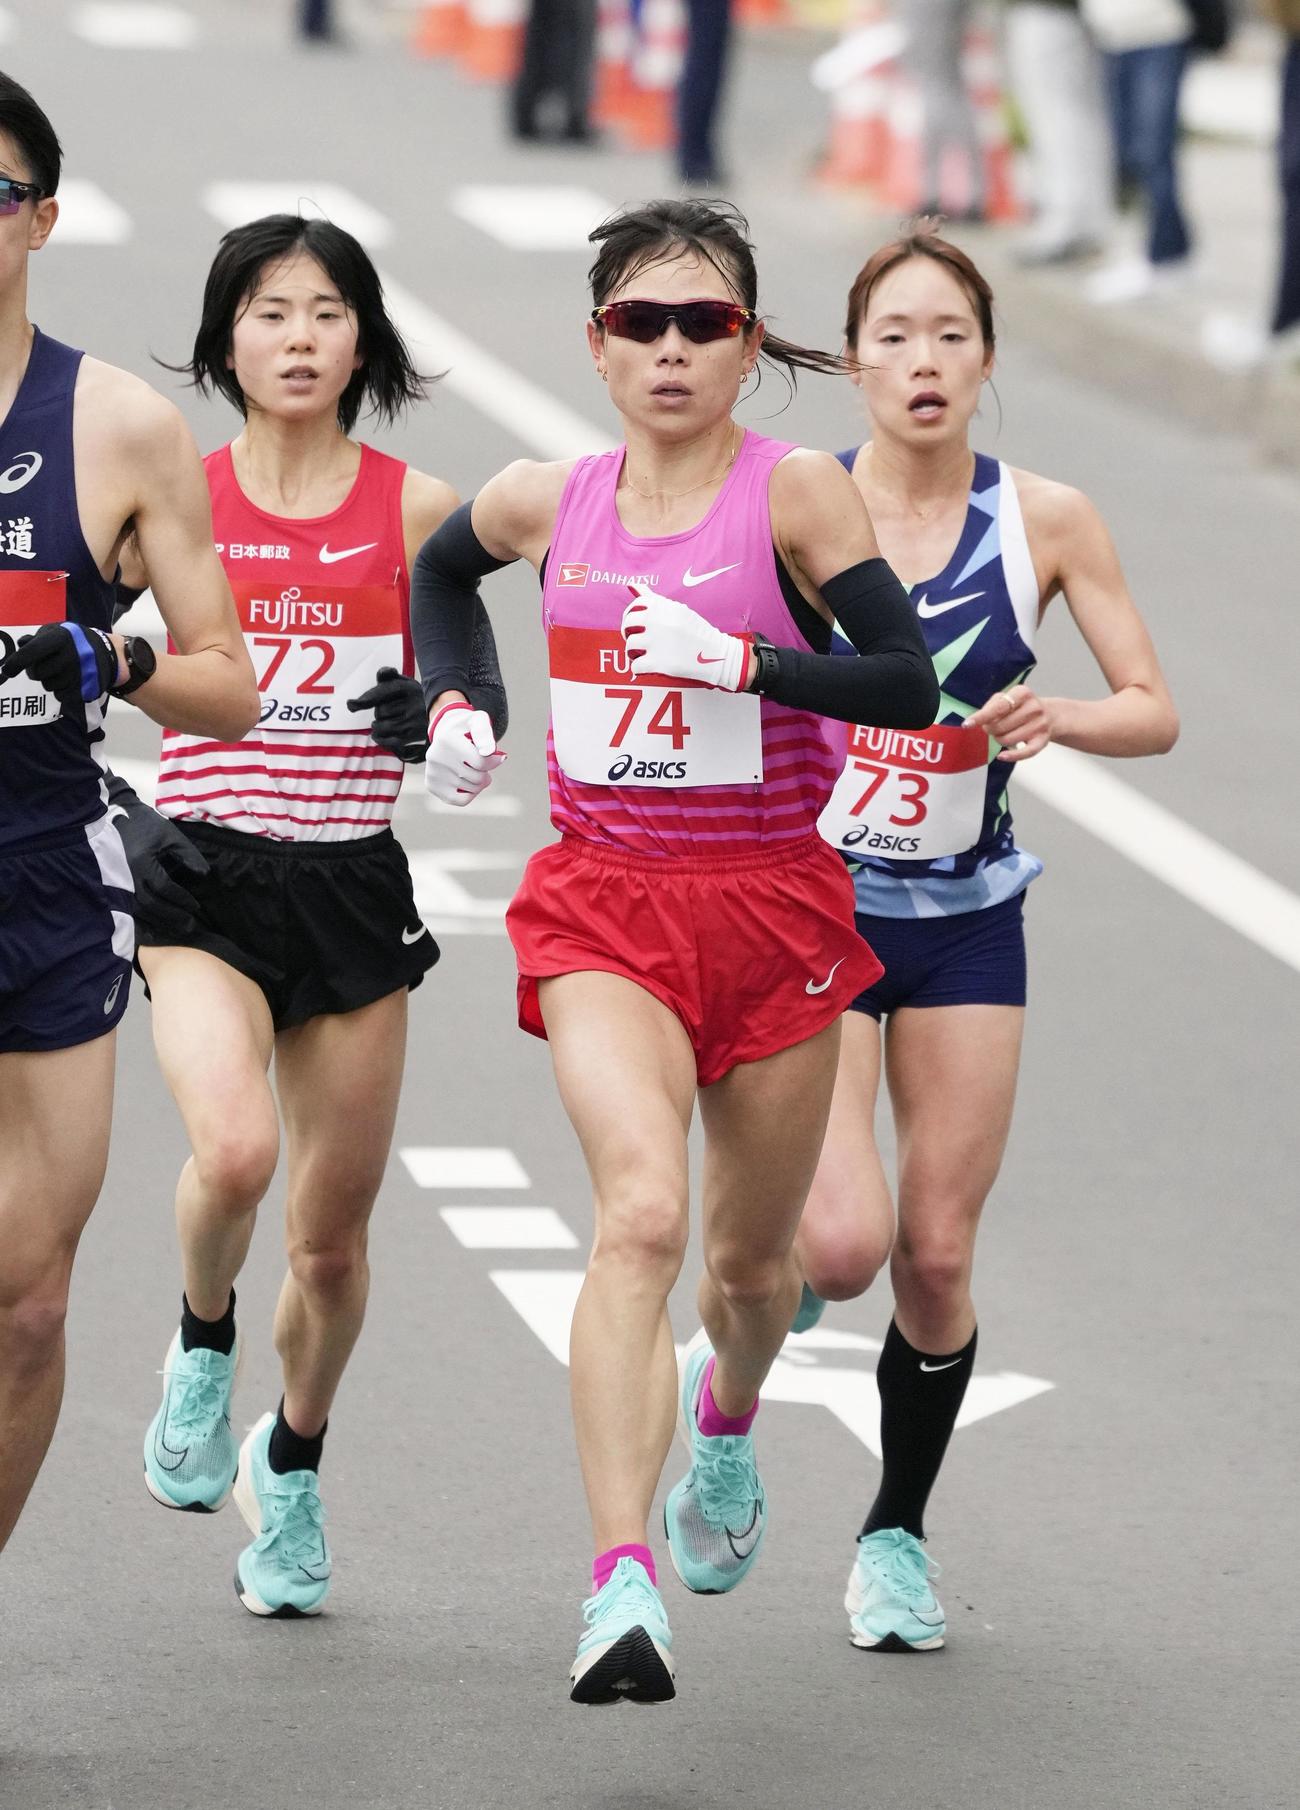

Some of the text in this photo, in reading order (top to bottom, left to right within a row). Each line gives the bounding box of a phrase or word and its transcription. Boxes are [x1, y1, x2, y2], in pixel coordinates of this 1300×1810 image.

[229, 543, 291, 560] 日本郵政
[591, 570, 660, 586] DAIHATSU
[249, 587, 344, 632] FUJITSU
[253, 636, 336, 695] 72
[0, 694, 46, 719] 印刷
[278, 705, 332, 722] asics
[604, 688, 691, 750] 74
[852, 724, 945, 764] FUJITSU
[633, 761, 687, 779] asics
[848, 760, 930, 828] 73
[867, 832, 921, 853] asics
